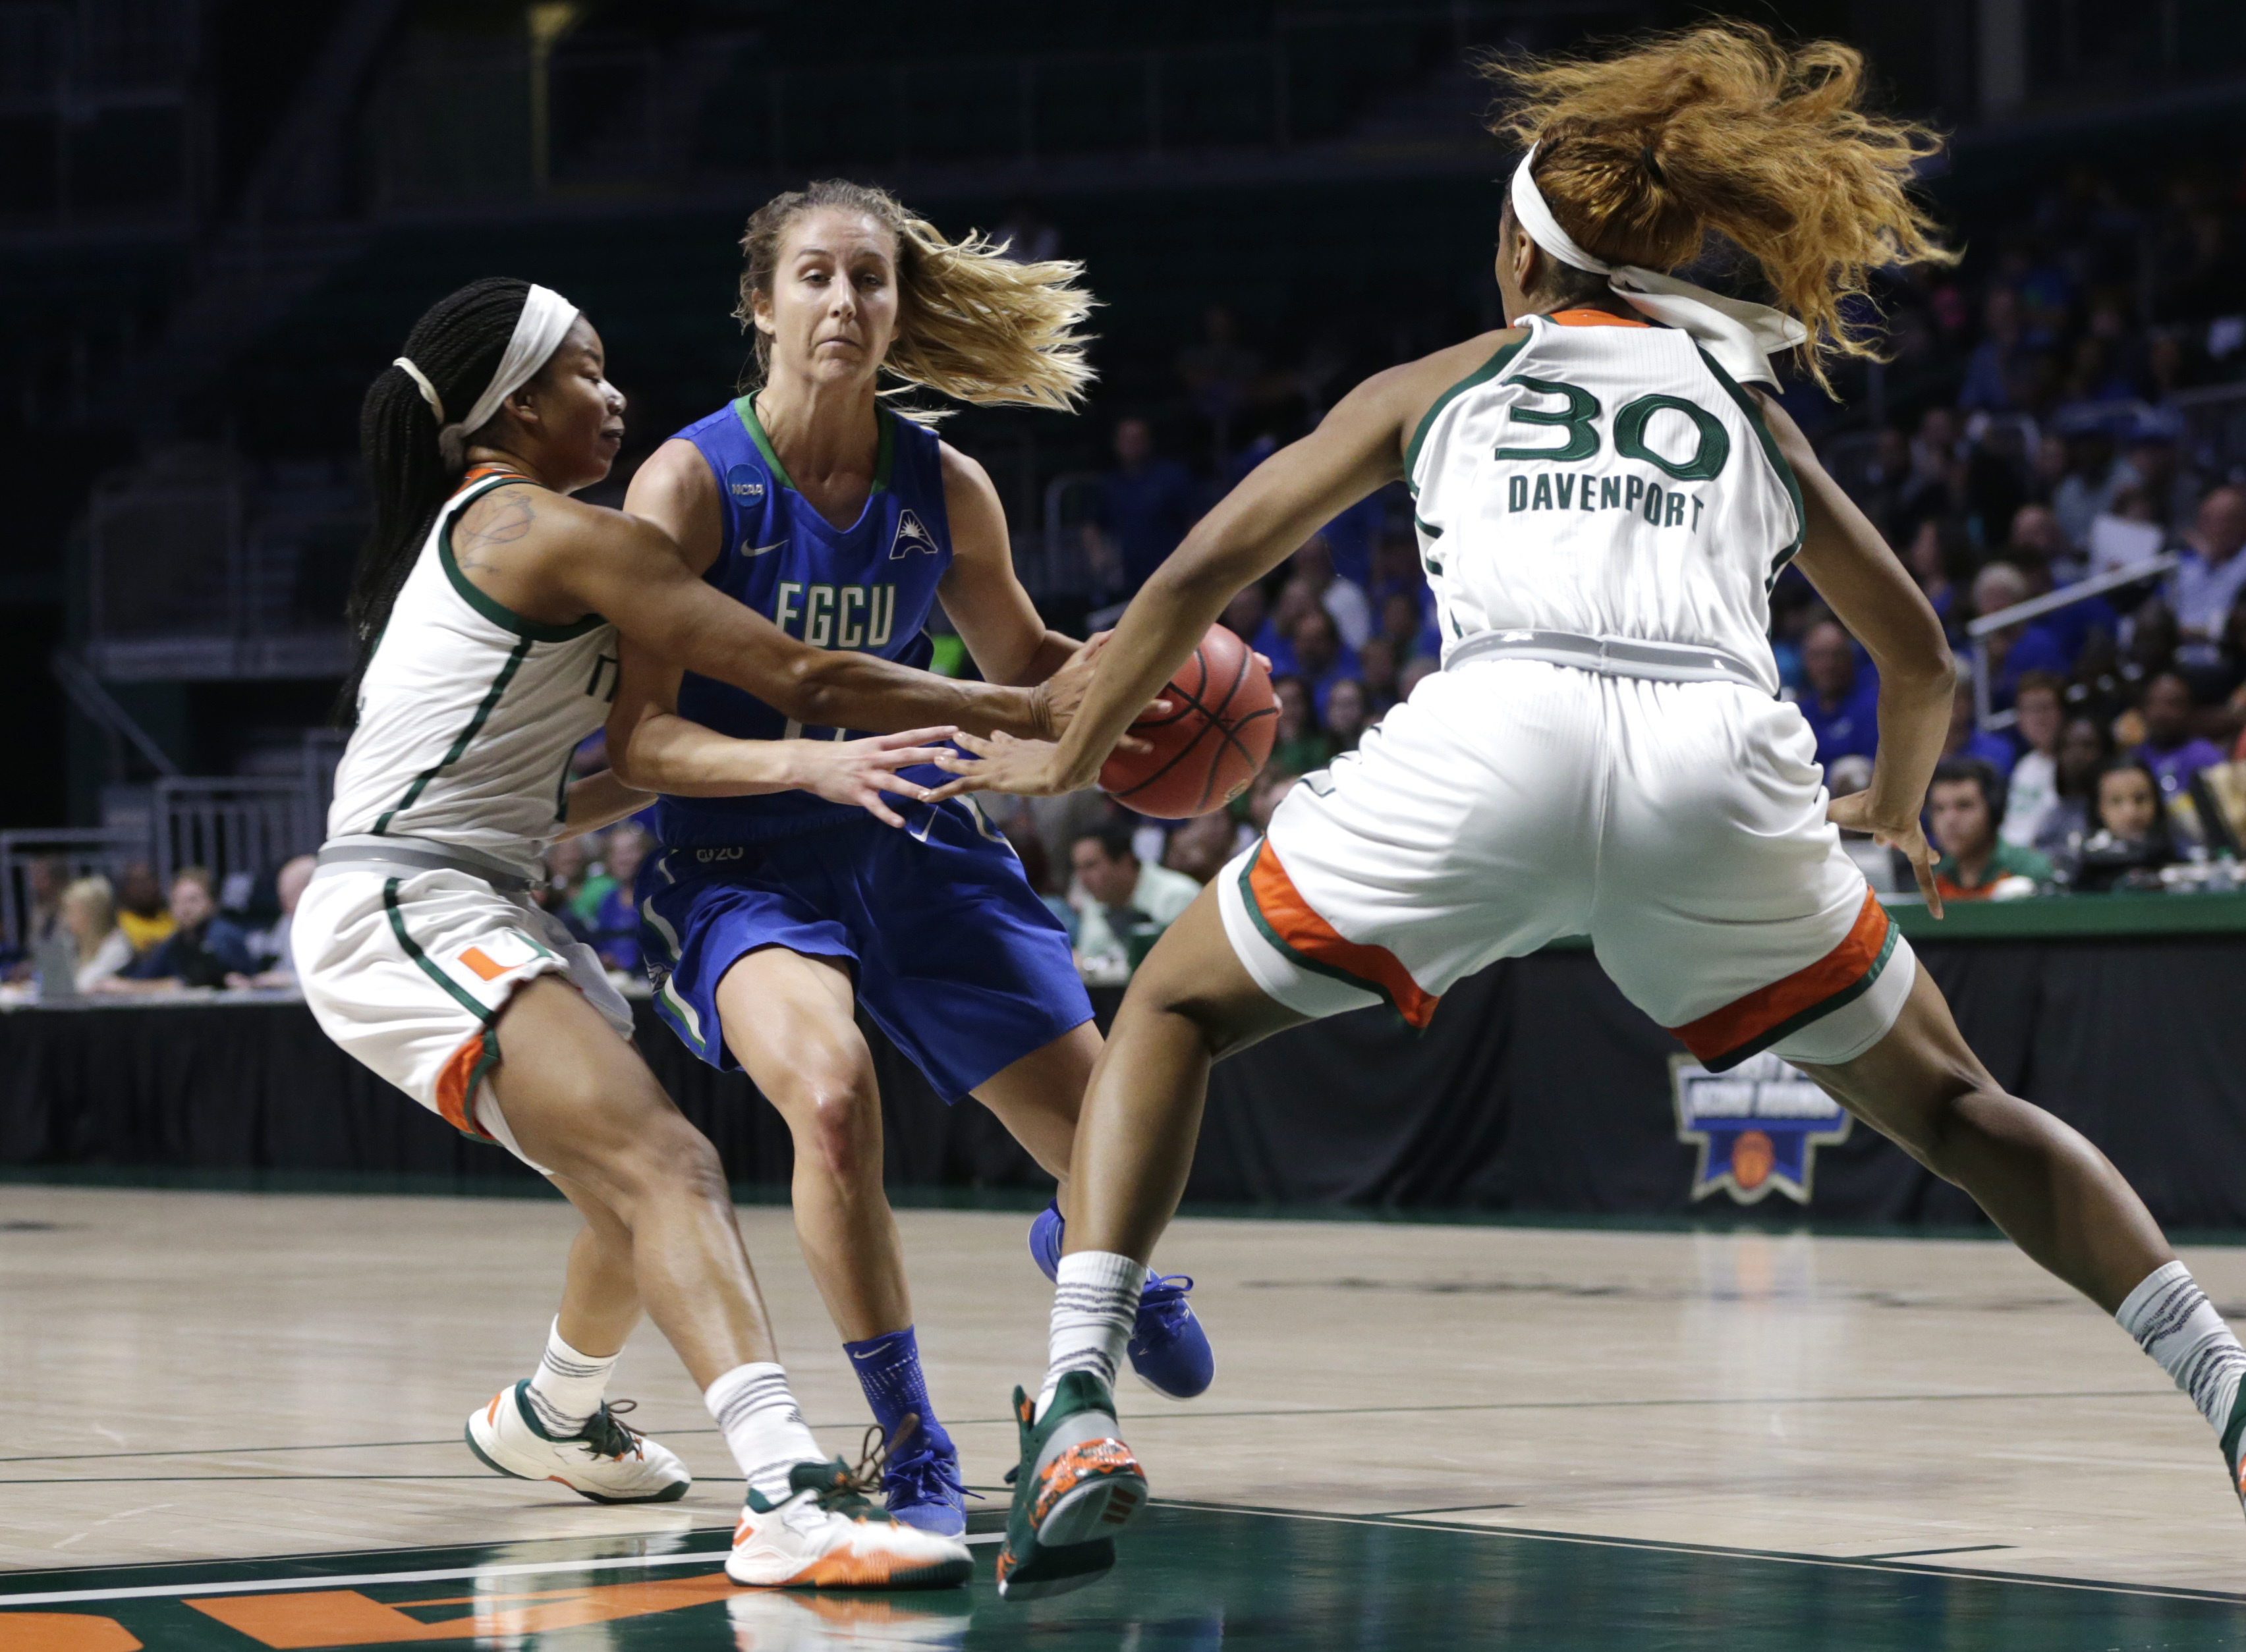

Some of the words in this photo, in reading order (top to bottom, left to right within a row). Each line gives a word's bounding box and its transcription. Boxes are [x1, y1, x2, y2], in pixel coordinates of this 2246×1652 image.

[1494, 374, 1731, 482] 30
[731, 483, 764, 495] NCAA
[1508, 472, 1704, 535] DAVENPORT
[775, 580, 896, 647] FGCU
